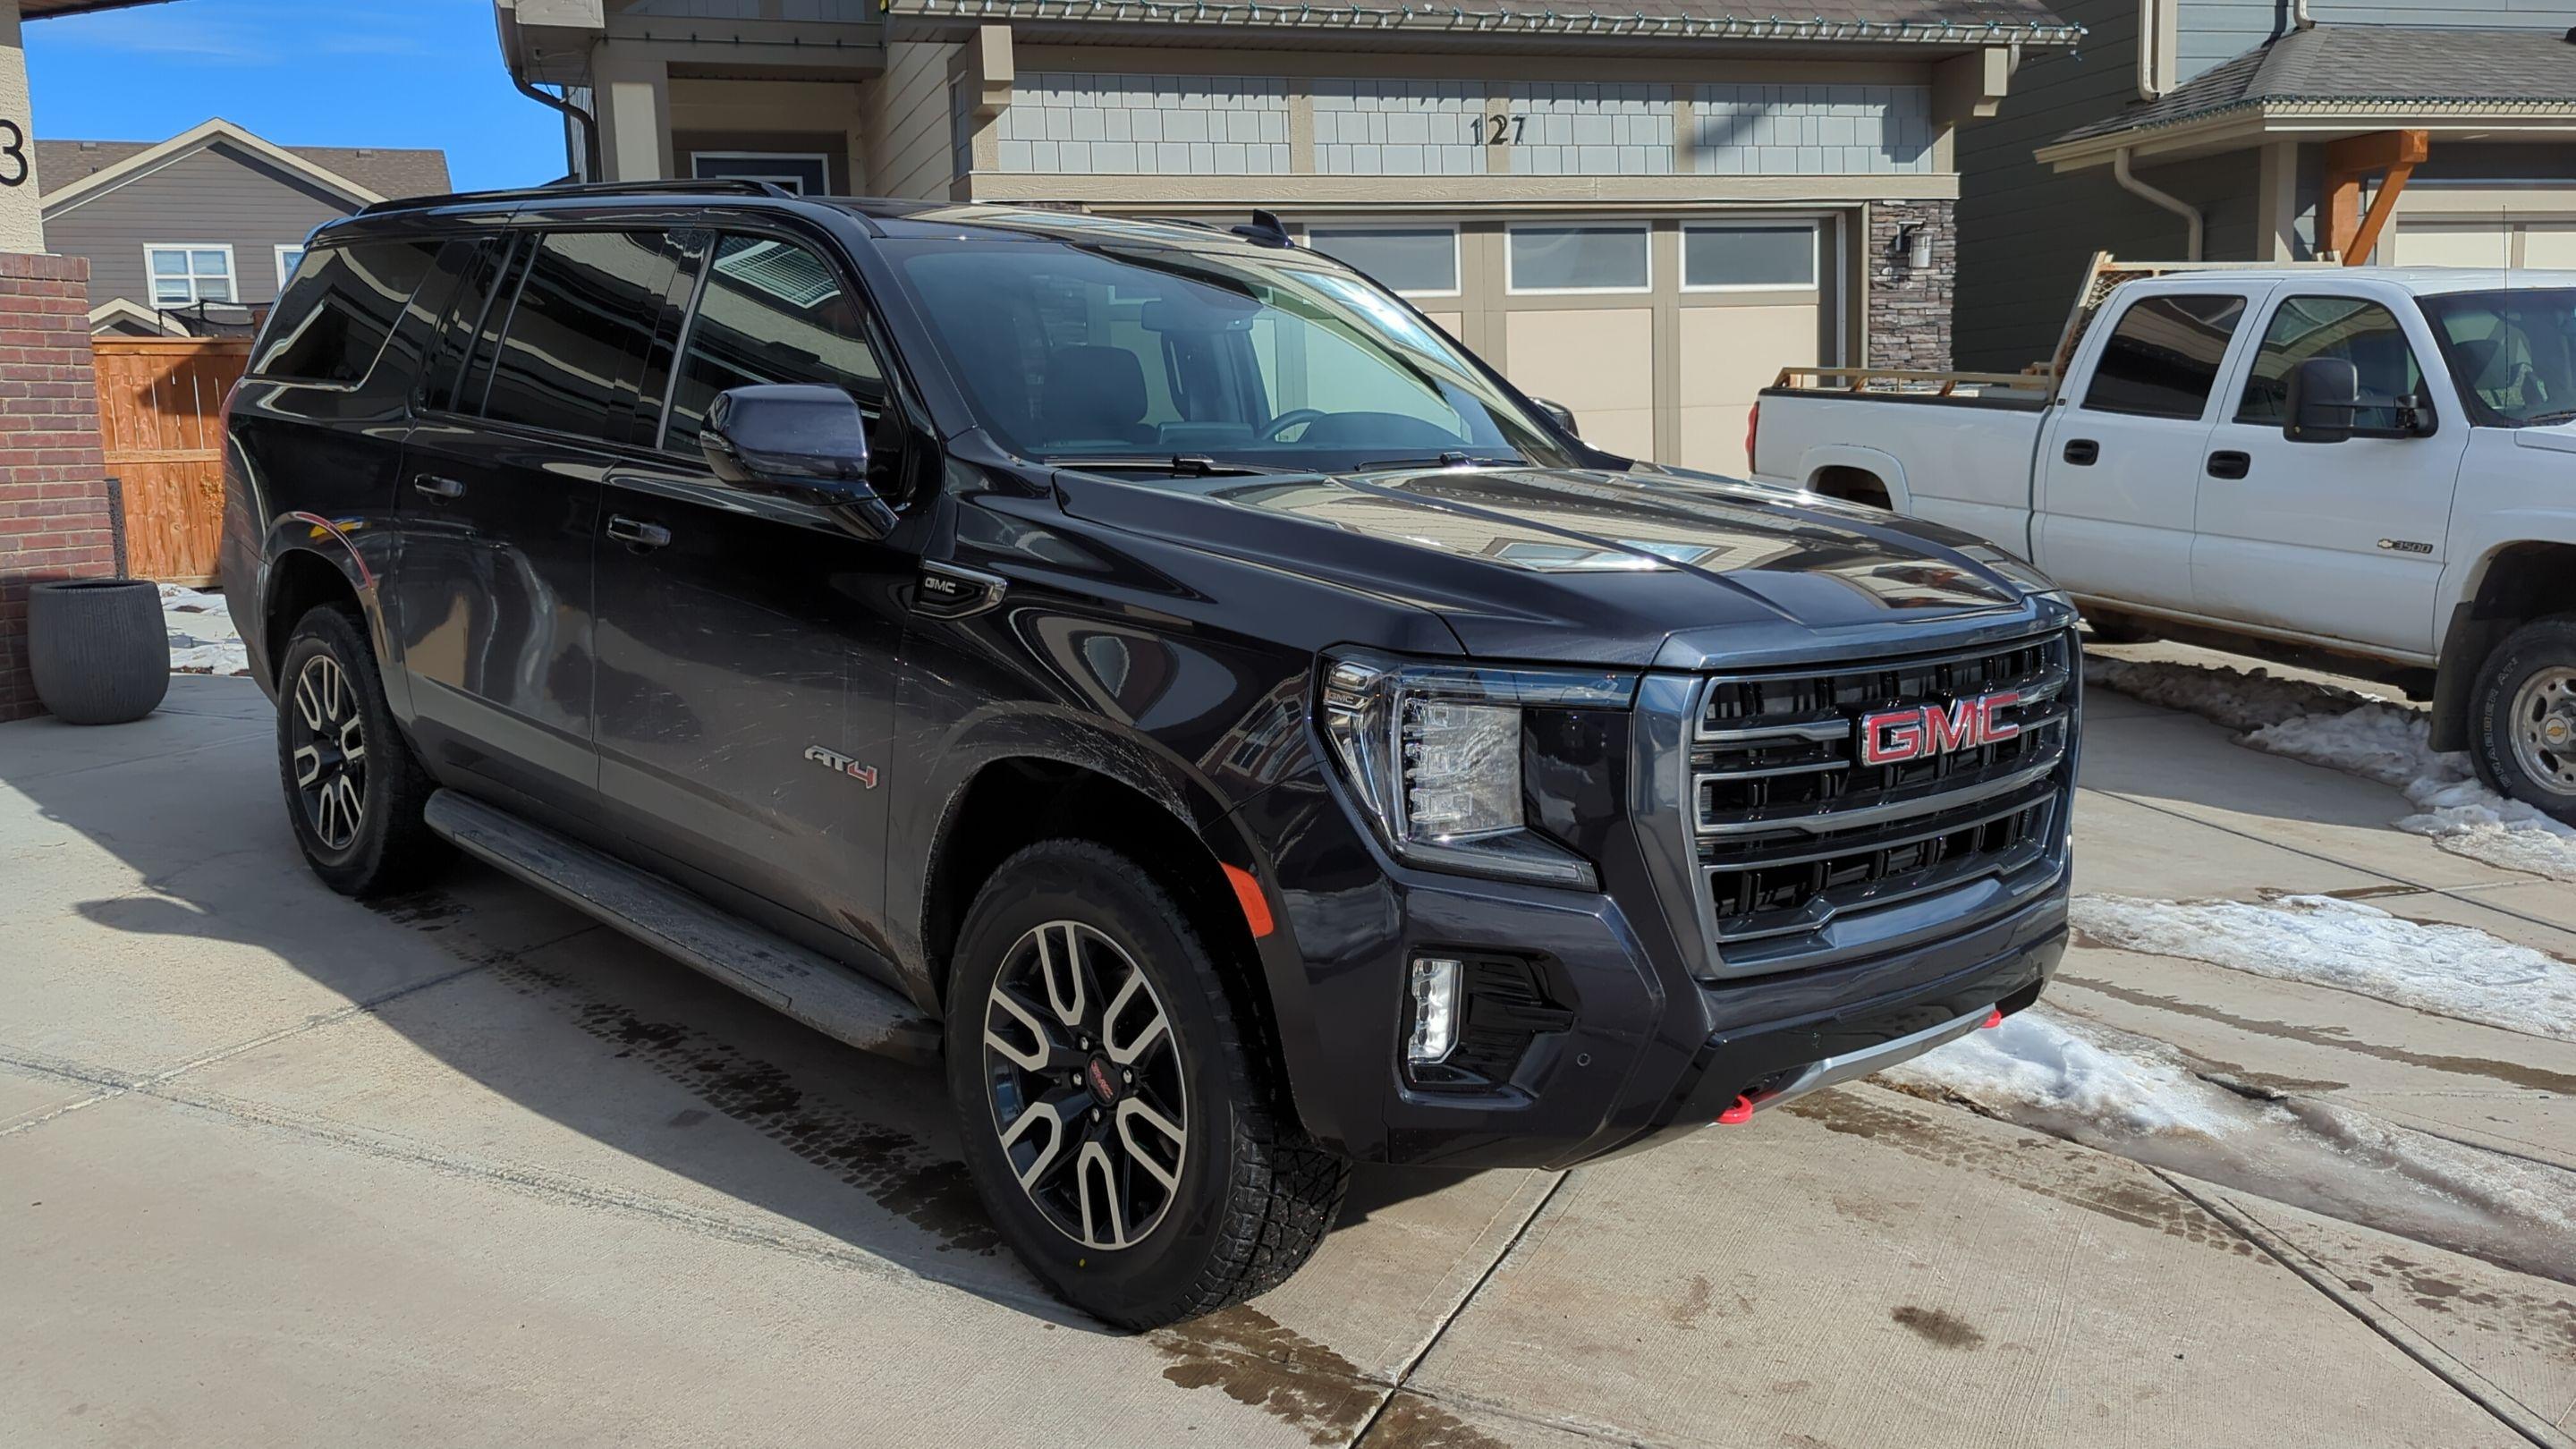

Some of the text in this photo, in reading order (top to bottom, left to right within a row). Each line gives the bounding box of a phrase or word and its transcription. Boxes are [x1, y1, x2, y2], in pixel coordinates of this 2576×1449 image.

[1470, 114, 1526, 146] 127
[0, 118, 29, 187] 3
[2396, 541, 2431, 554] 3500
[924, 576, 956, 594] GMC
[1328, 691, 1354, 704] GMC
[1860, 691, 2020, 767] GMC
[804, 744, 877, 789] AT4
